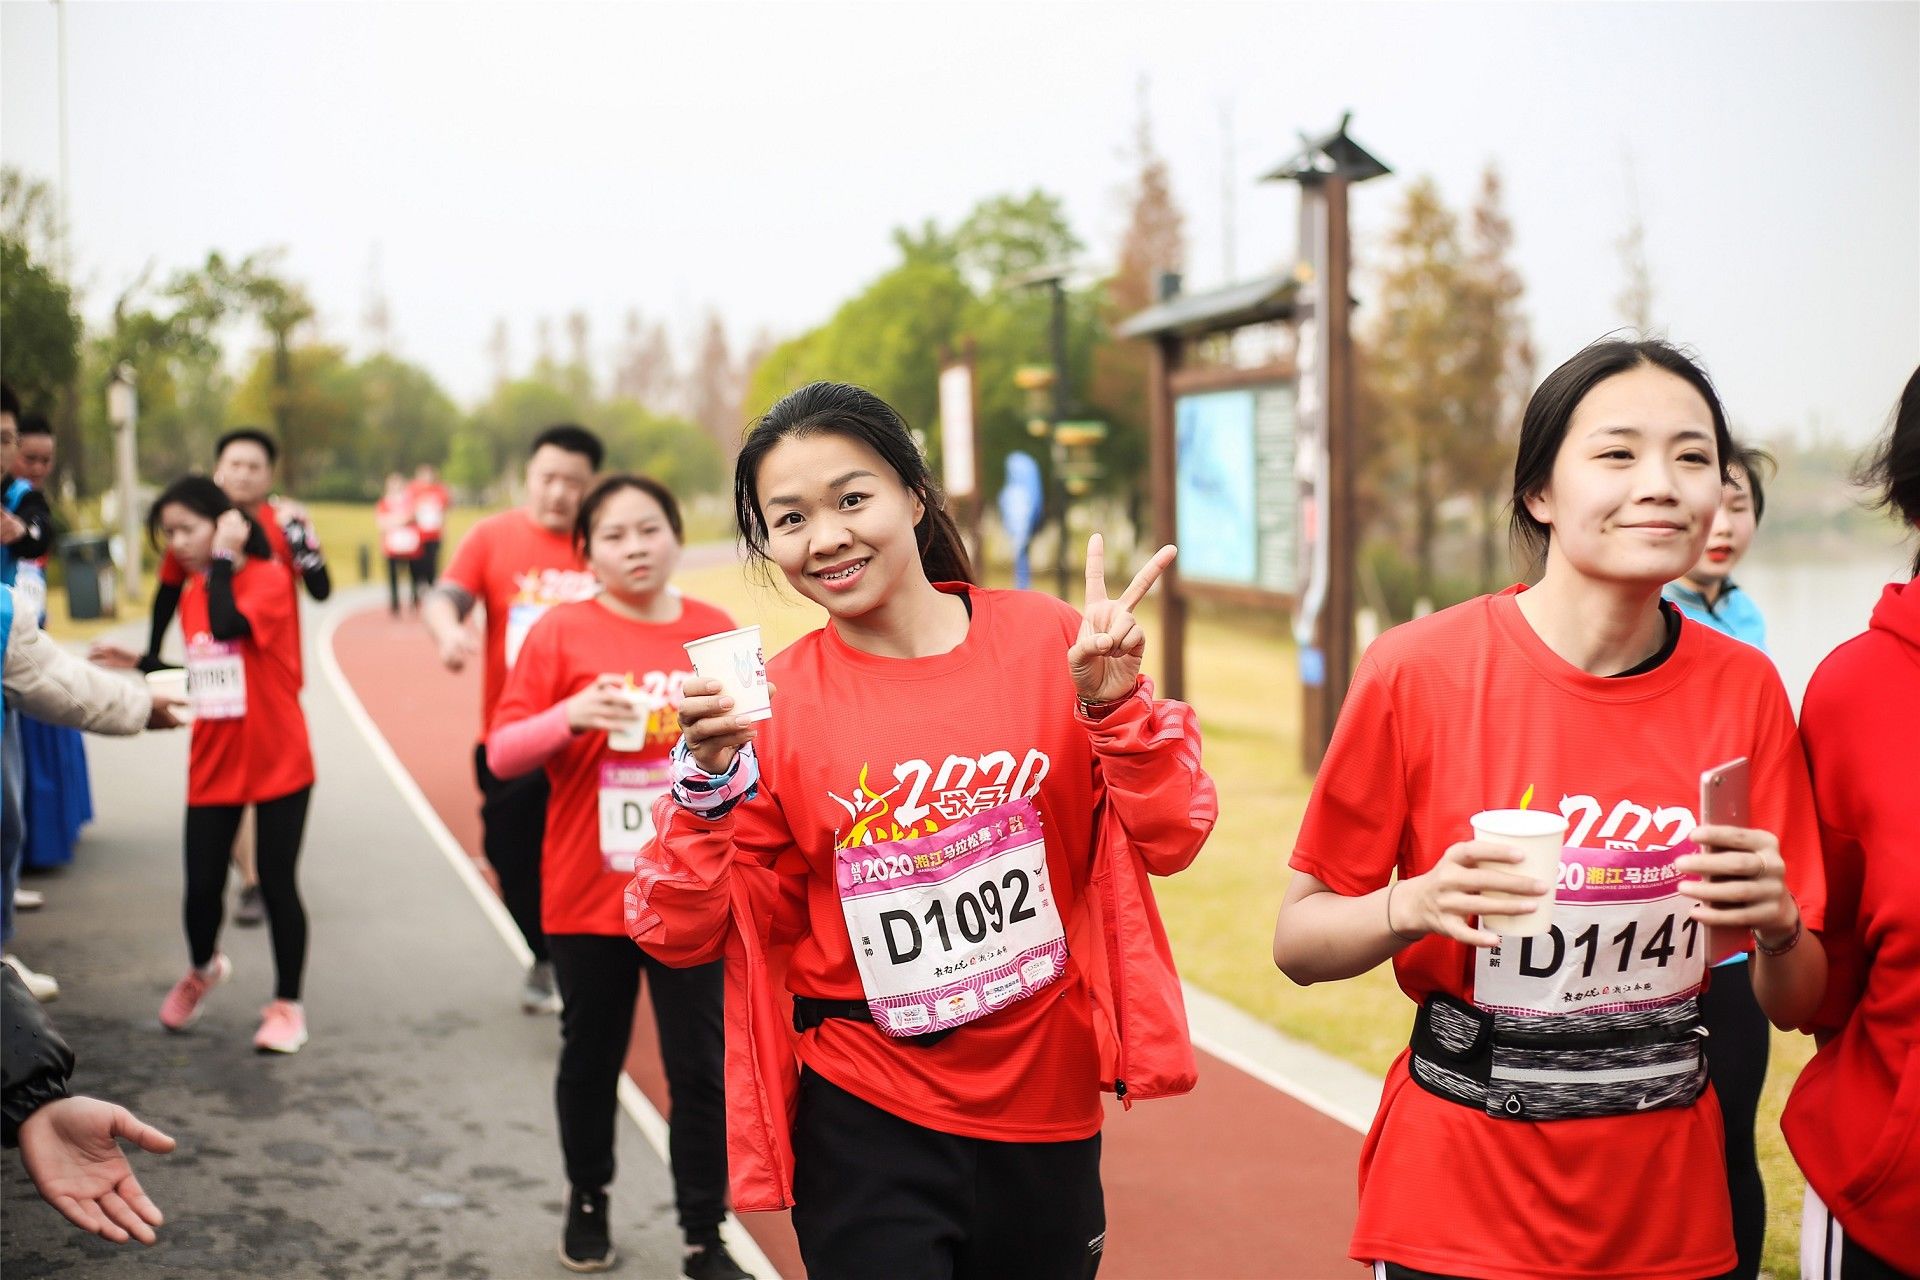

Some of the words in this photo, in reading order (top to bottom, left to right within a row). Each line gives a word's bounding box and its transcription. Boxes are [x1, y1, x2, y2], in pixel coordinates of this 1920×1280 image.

[1558, 793, 1696, 850] 202
[863, 854, 915, 883] 2020
[913, 826, 993, 869] 湘江马拉松赛
[1586, 863, 1684, 885] 湘江马拉松
[879, 868, 1037, 966] D1092
[1518, 903, 1702, 979] D1141
[1489, 934, 1503, 968] 建新
